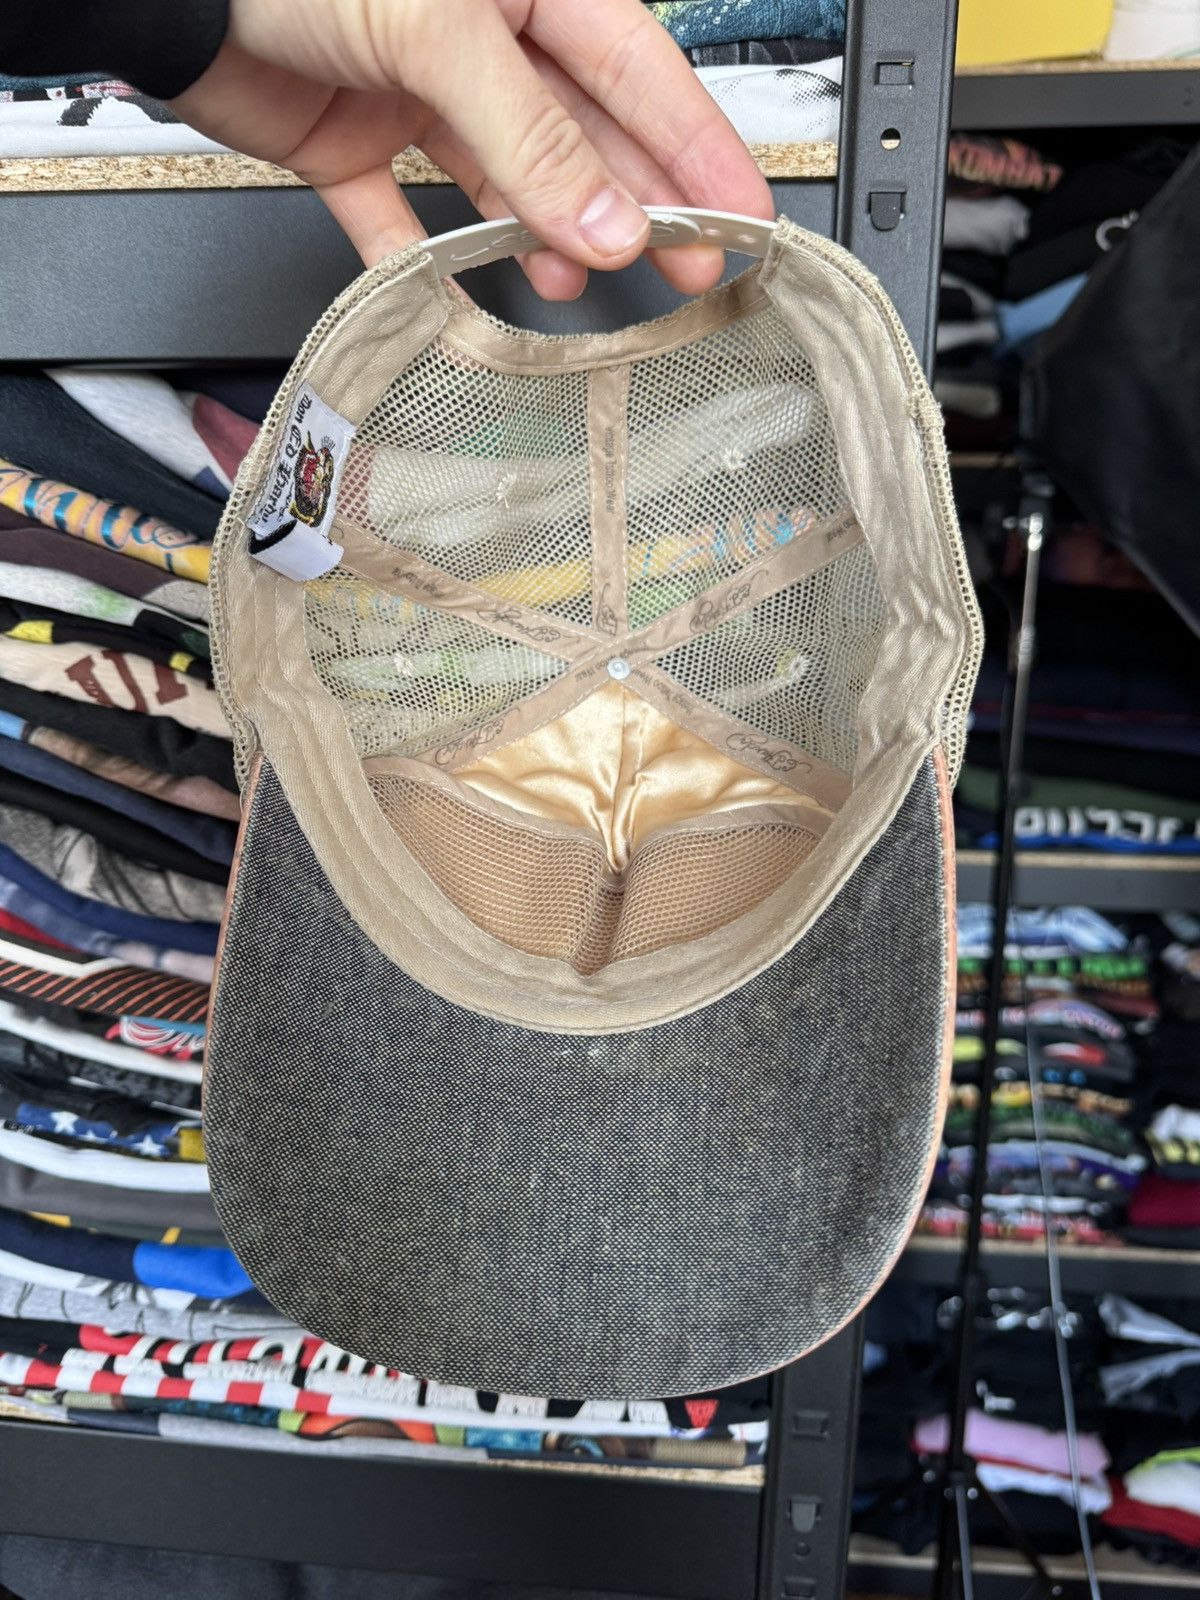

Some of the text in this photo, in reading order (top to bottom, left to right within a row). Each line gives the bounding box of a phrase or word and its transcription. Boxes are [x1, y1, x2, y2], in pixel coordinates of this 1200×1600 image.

[296, 393, 313, 423] Don
[286, 425, 302, 458] Ed
[260, 462, 292, 523] Hardy
